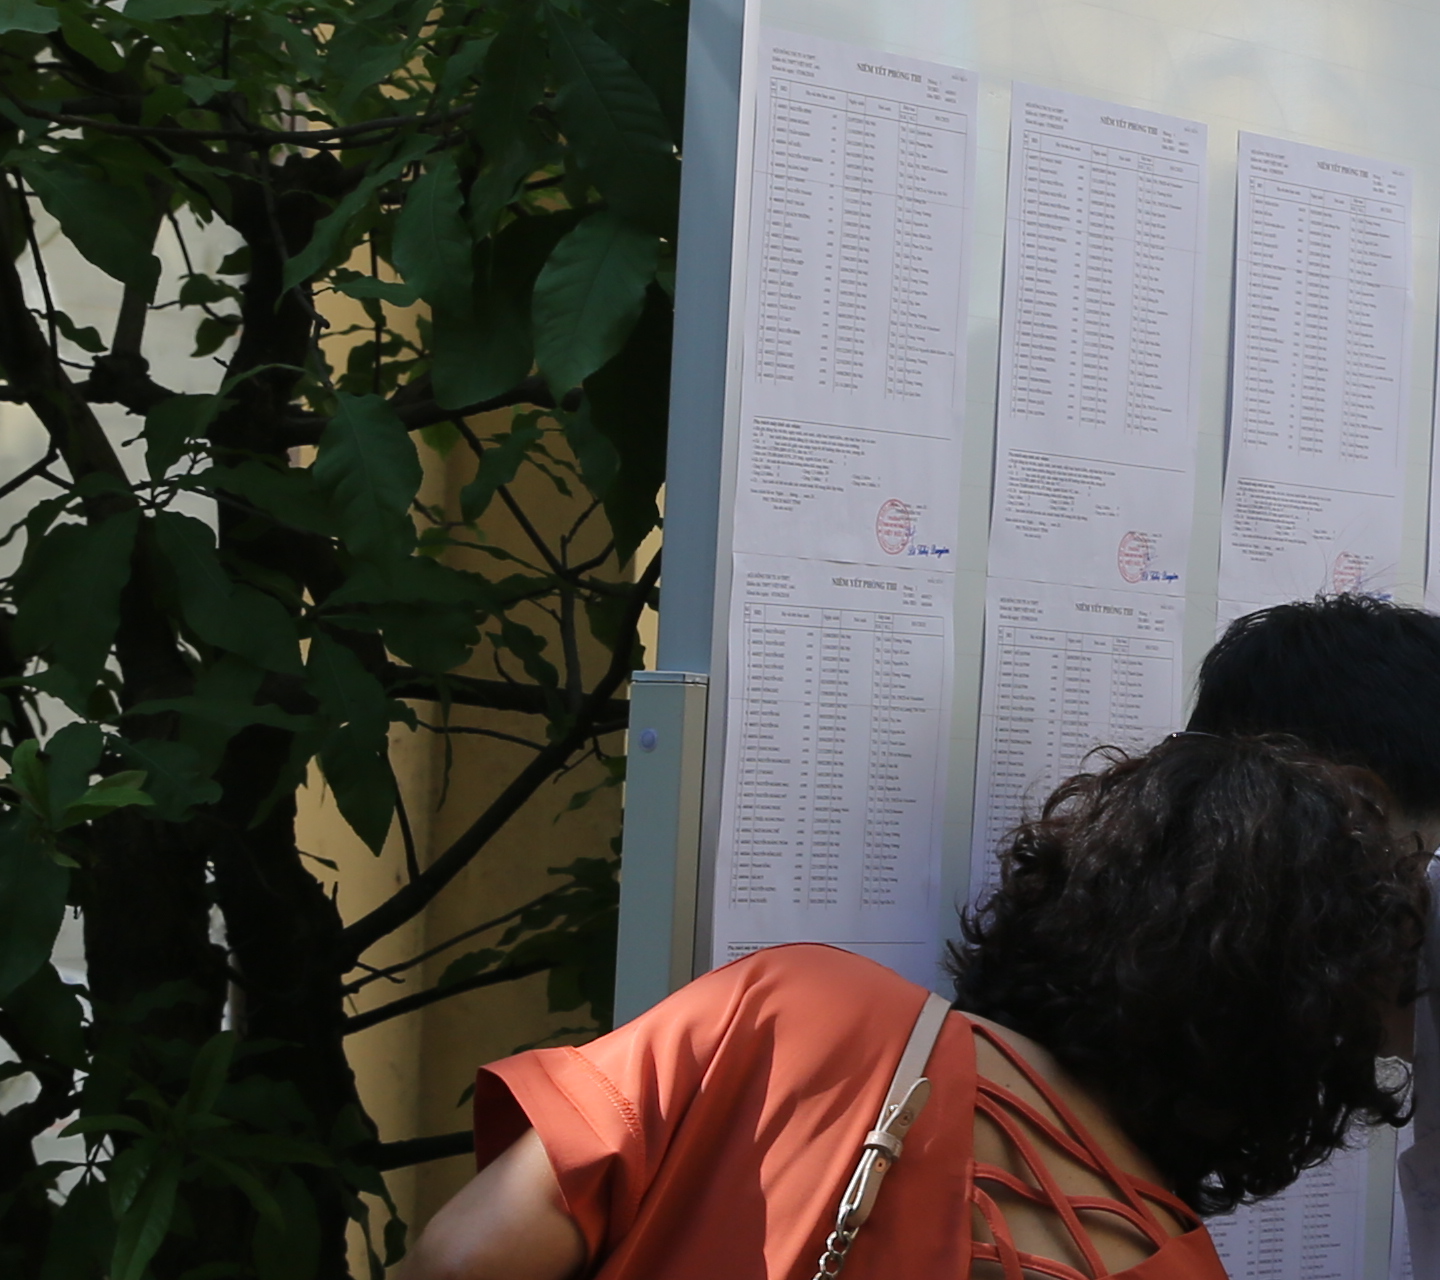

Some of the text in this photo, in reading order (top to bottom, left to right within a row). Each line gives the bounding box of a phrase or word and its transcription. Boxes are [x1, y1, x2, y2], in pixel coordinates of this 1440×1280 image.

[857, 63, 922, 83] NIÊM YẾT PHÒNG THI
[1100, 116, 1158, 135] NIÊM YẾT PHÒNG THI
[832, 576, 897, 591] NIÊM YẾT PHÒNG THI
[1075, 602, 1134, 616] NIÊM YẾT PHÒNG THI
